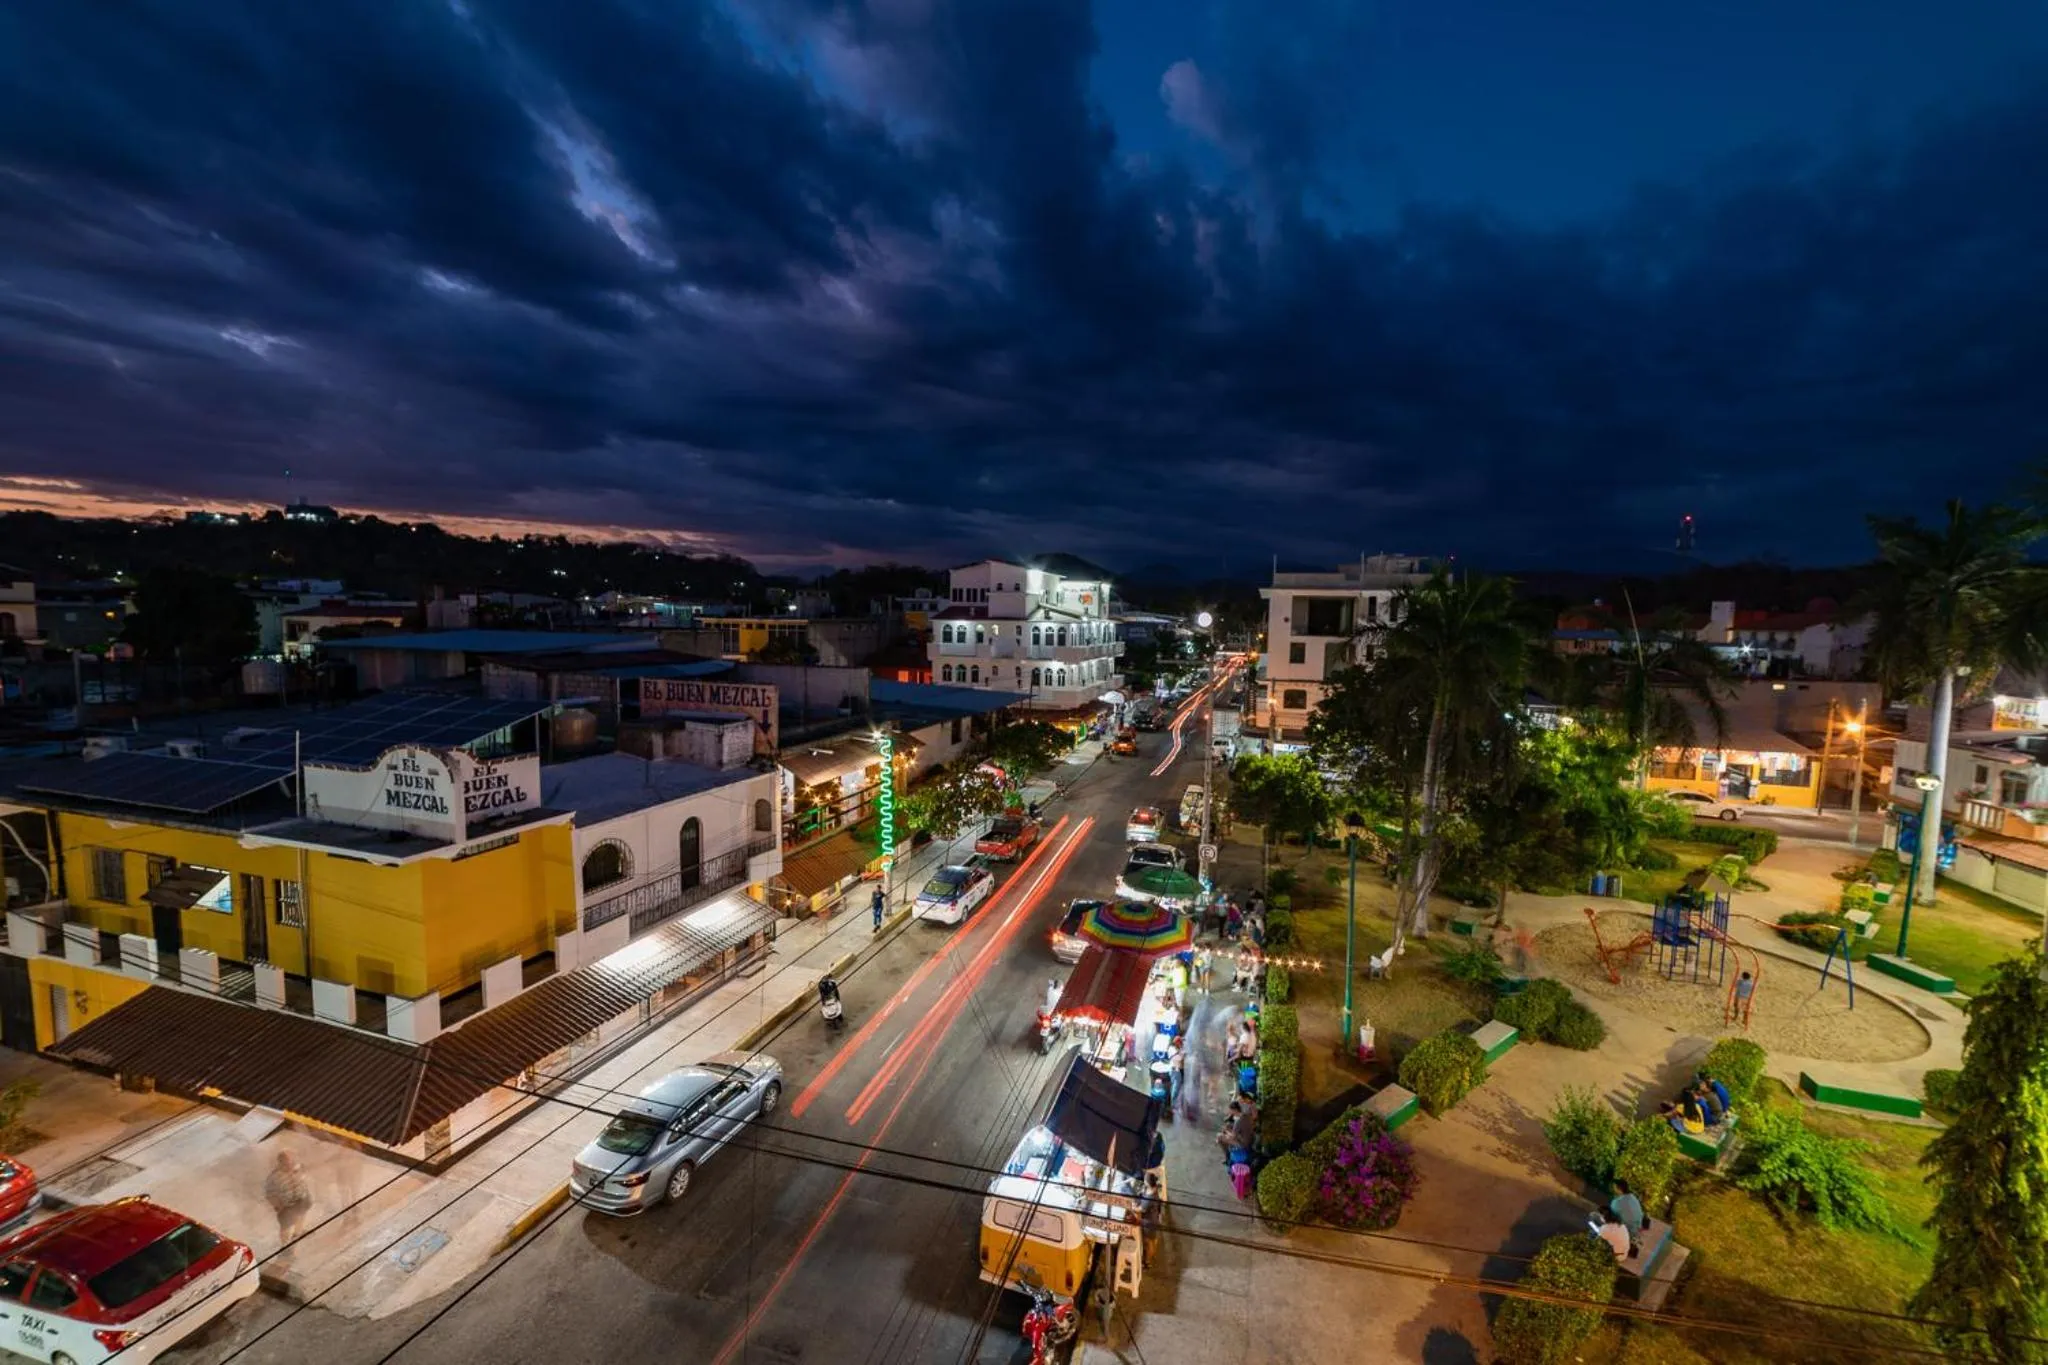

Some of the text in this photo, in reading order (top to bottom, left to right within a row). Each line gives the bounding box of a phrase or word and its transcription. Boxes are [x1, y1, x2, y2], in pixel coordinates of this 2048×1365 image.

[643, 681, 772, 708] EL BUEN MEZCAL
[402, 759, 421, 772] EL
[473, 766, 498, 777] EL
[394, 774, 435, 791] BUEN
[385, 789, 449, 814] MEZCAL
[464, 786, 527, 814] EZCAL
[21, 1313, 46, 1332] TAXI
